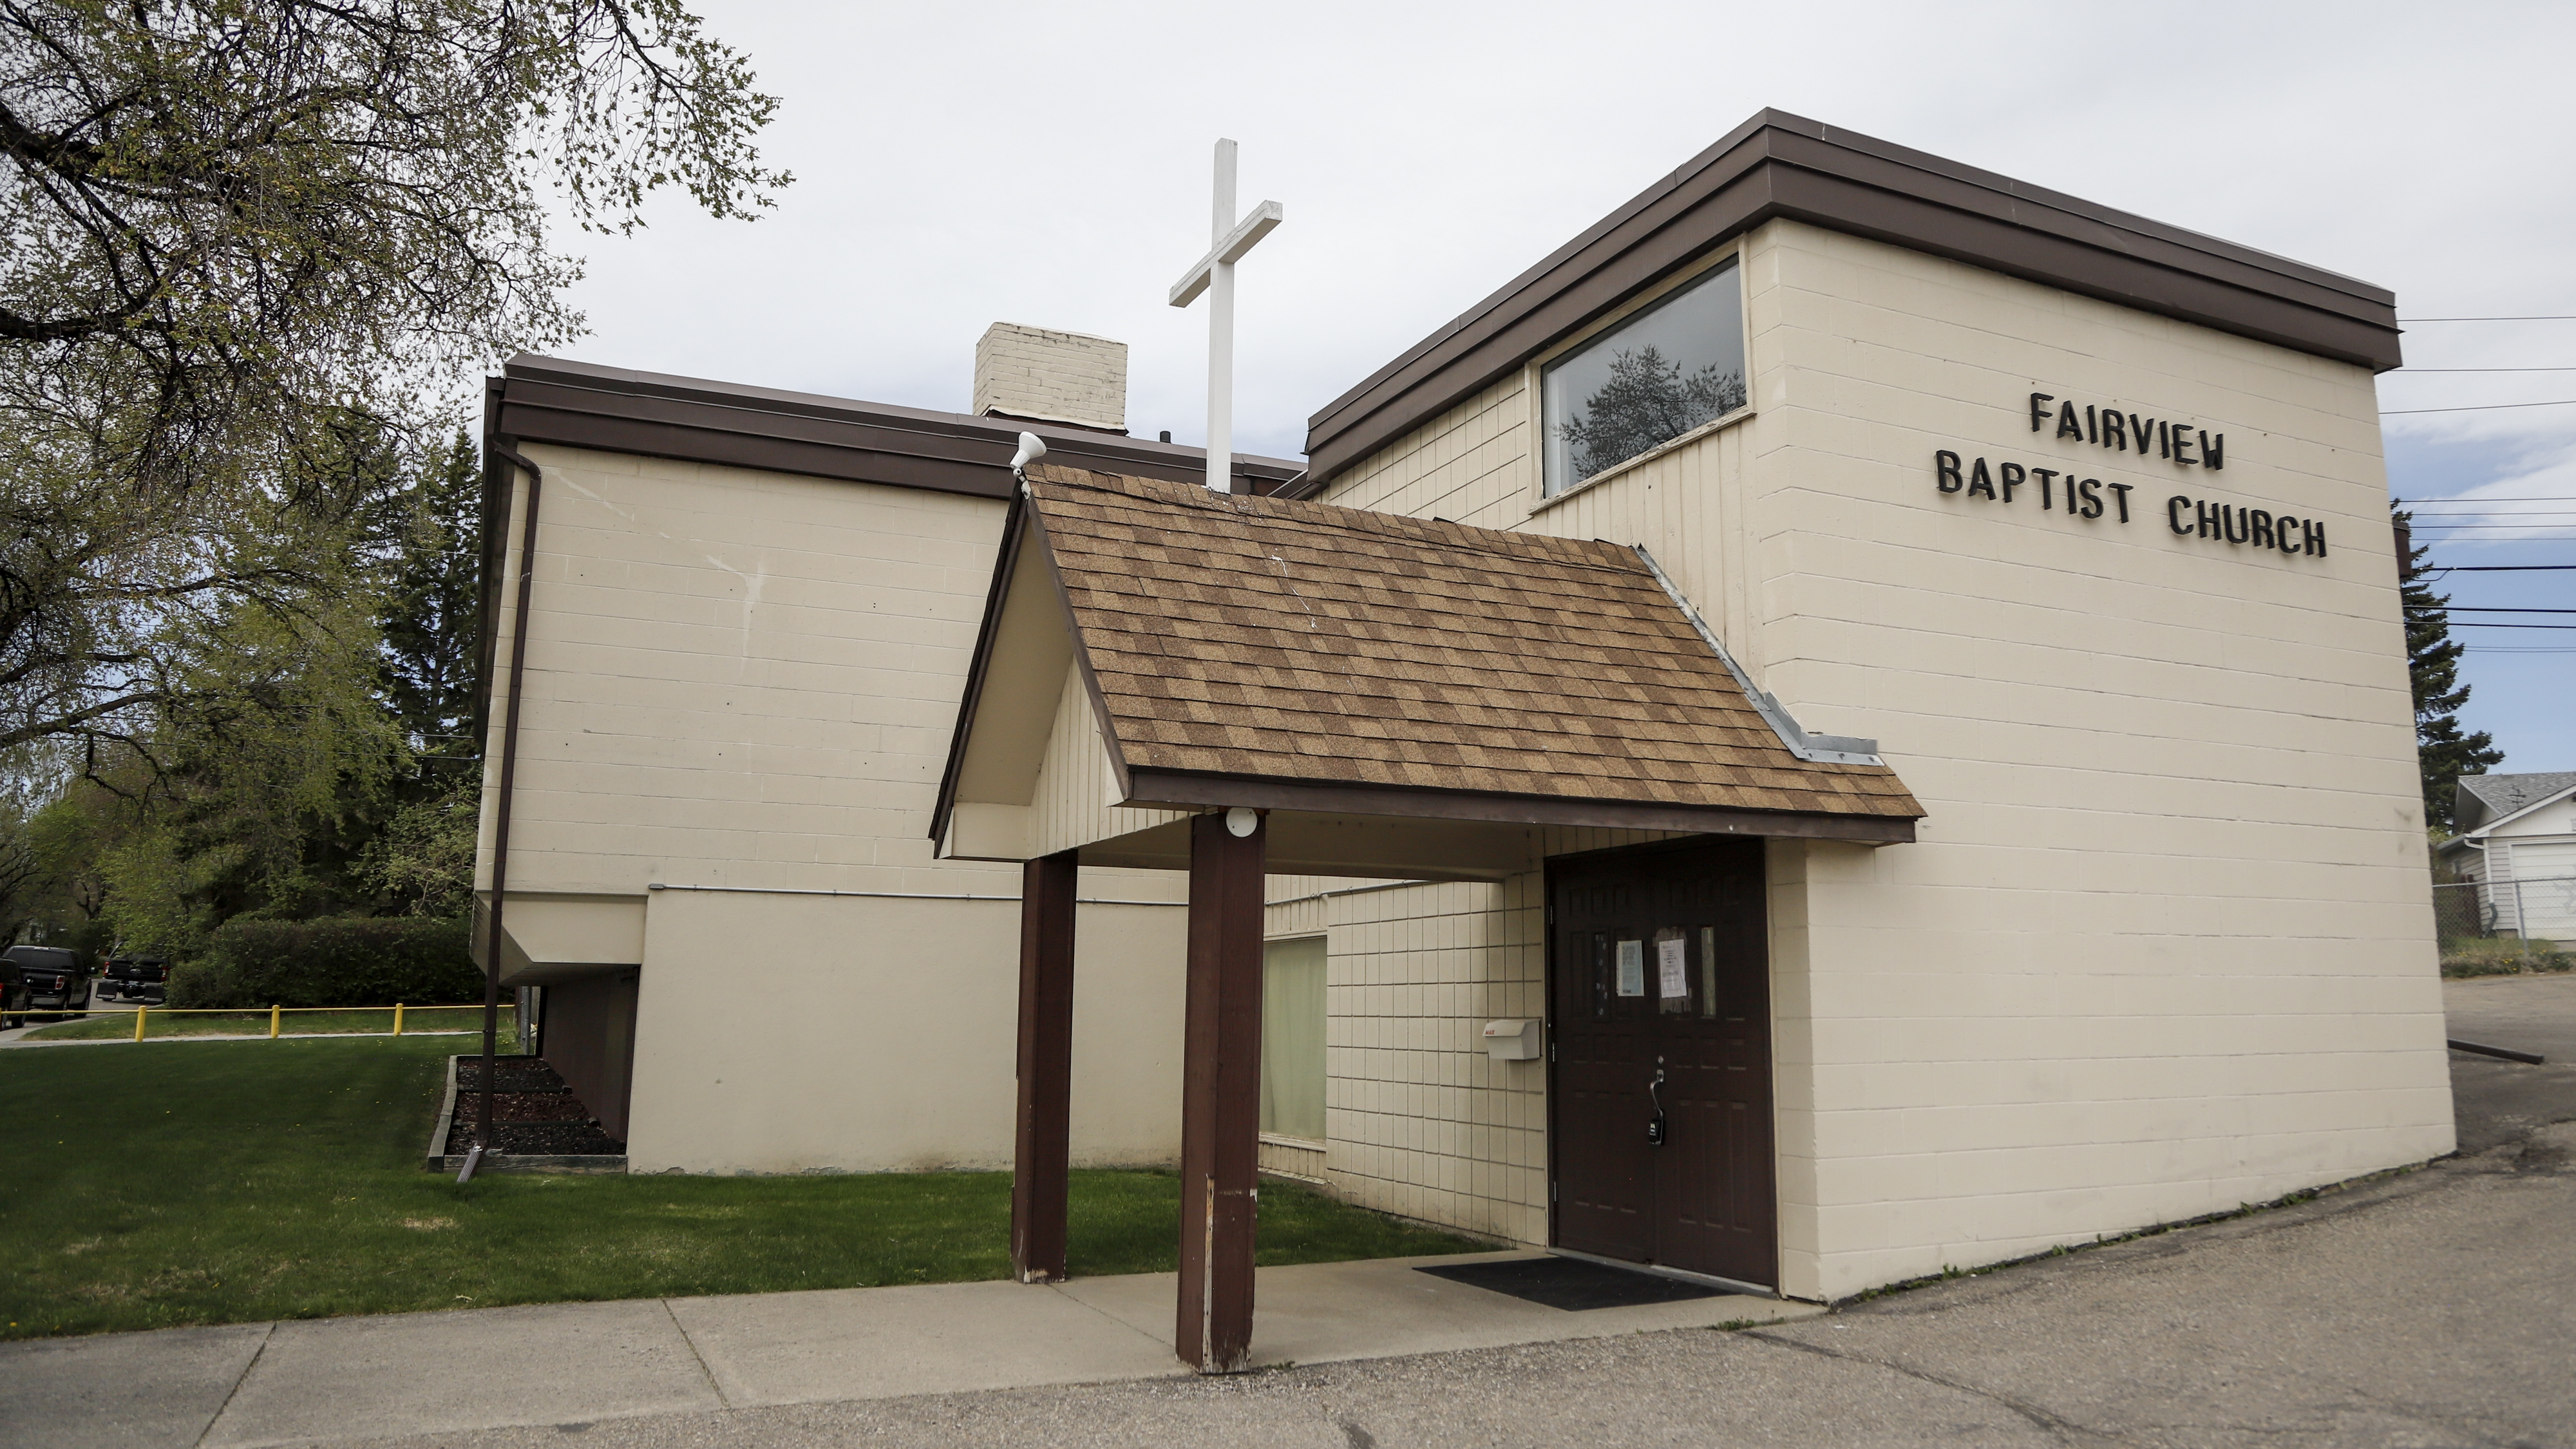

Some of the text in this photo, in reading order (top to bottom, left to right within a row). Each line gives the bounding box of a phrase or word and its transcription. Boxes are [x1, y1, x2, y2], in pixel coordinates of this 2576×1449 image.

[2030, 392, 2224, 471] FAIRVIEW
[1935, 450, 2327, 559] BAPTIST CHURCH
